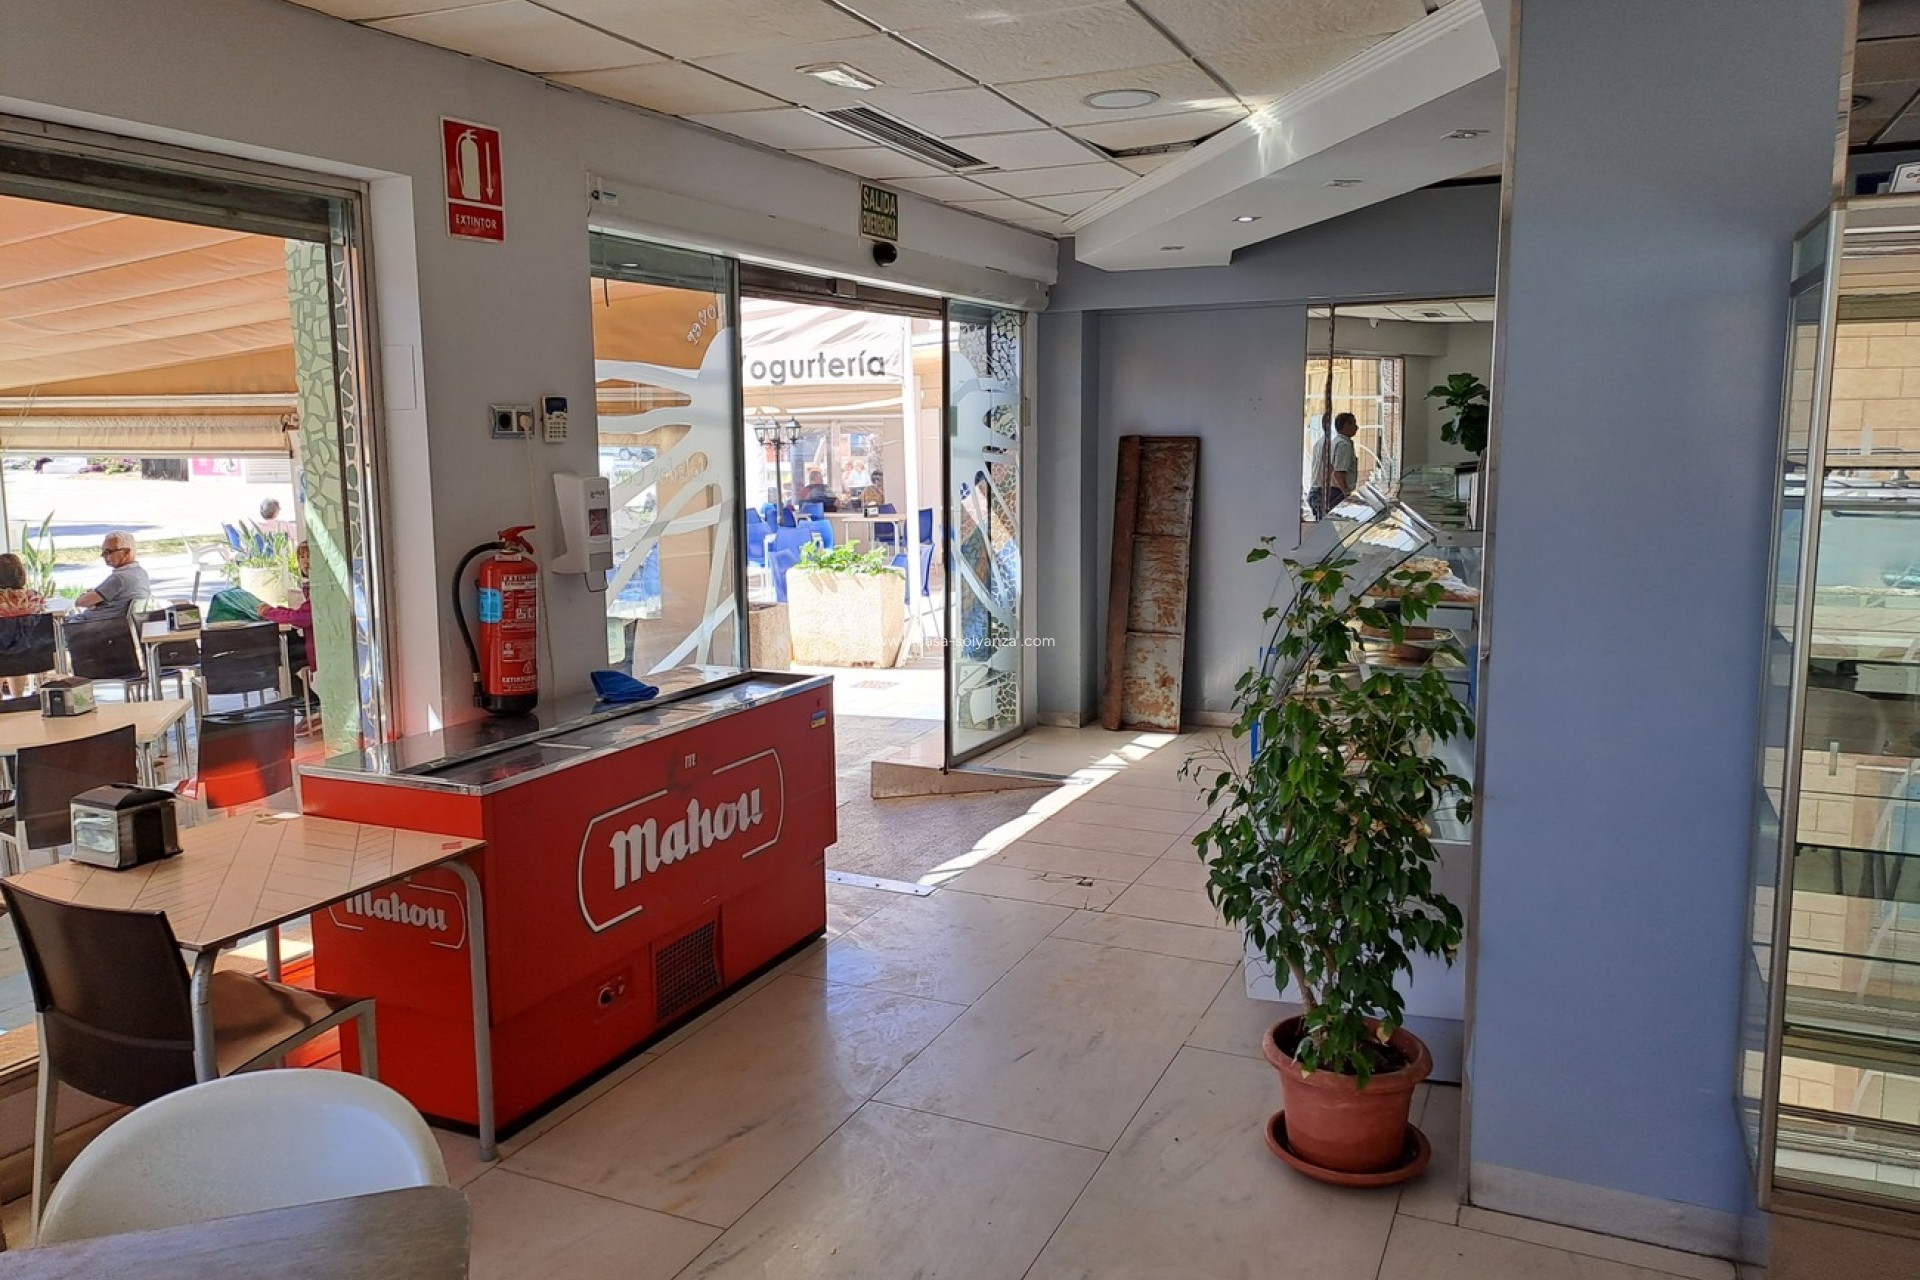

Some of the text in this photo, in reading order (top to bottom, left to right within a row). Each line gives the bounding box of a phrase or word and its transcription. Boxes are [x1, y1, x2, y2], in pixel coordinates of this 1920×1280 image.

[863, 187, 896, 215] SALIDA
[456, 213, 498, 230] EXTINTOR
[743, 350, 886, 385] ogurtería
[609, 787, 763, 890] Mahou
[344, 891, 448, 931] Mahou
